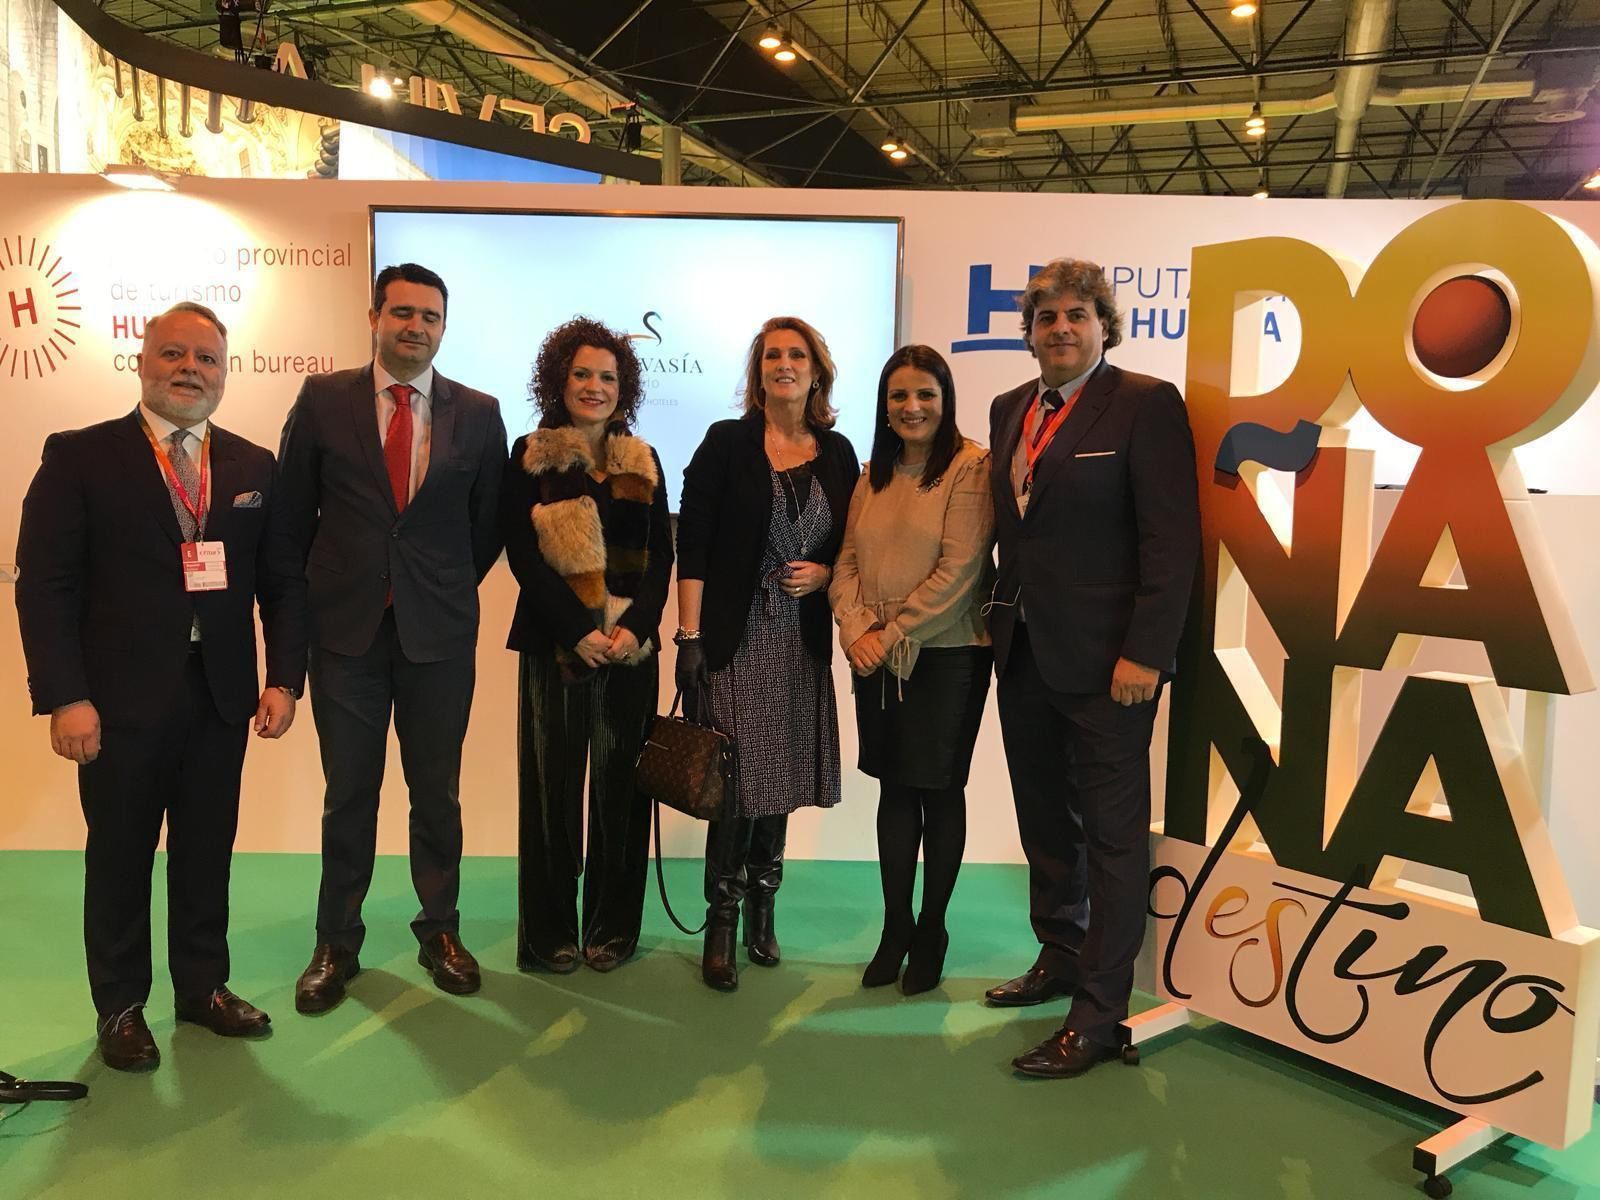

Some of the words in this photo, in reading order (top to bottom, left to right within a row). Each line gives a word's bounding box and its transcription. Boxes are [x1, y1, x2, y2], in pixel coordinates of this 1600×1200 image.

[237, 241, 351, 271] provincial
[110, 277, 138, 302] de
[149, 280, 242, 303] turismo
[8, 287, 38, 329] H
[1131, 307, 1282, 343] HUA
[253, 350, 334, 373] bureau
[640, 352, 703, 374] VASÍA
[1147, 736, 1575, 1105] destino
